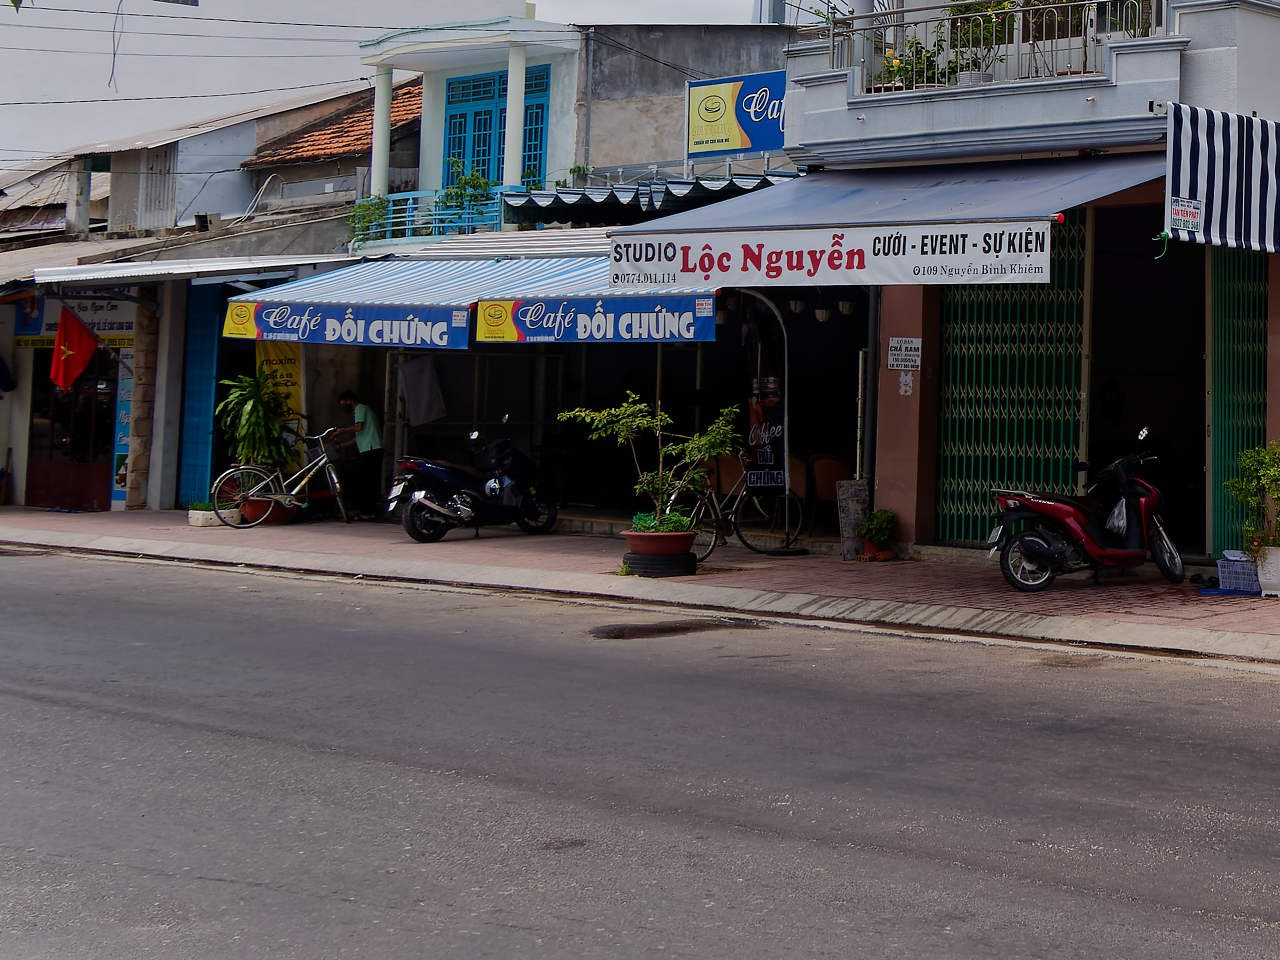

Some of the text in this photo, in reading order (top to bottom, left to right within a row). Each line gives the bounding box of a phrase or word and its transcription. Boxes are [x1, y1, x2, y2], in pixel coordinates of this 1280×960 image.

[613, 242, 677, 263] STUDIO
[680, 243, 732, 280] Lộc
[740, 233, 866, 279] Nguyễn
[872, 232, 907, 256] CƯỚI
[920, 233, 968, 255] EVENT
[982, 230, 1004, 258] SỰ
[1007, 227, 1045, 258] KIỆN
[922, 265, 938, 276] 109
[940, 263, 979, 278] Nguyễn
[1009, 263, 1044, 275] Khiêm
[262, 305, 322, 339] Café
[324, 307, 364, 343] ĐỐI
[368, 314, 449, 346] CHỨNG
[518, 301, 576, 339] Café
[576, 299, 615, 340] ĐỐI
[618, 304, 695, 340] CHỨNG
